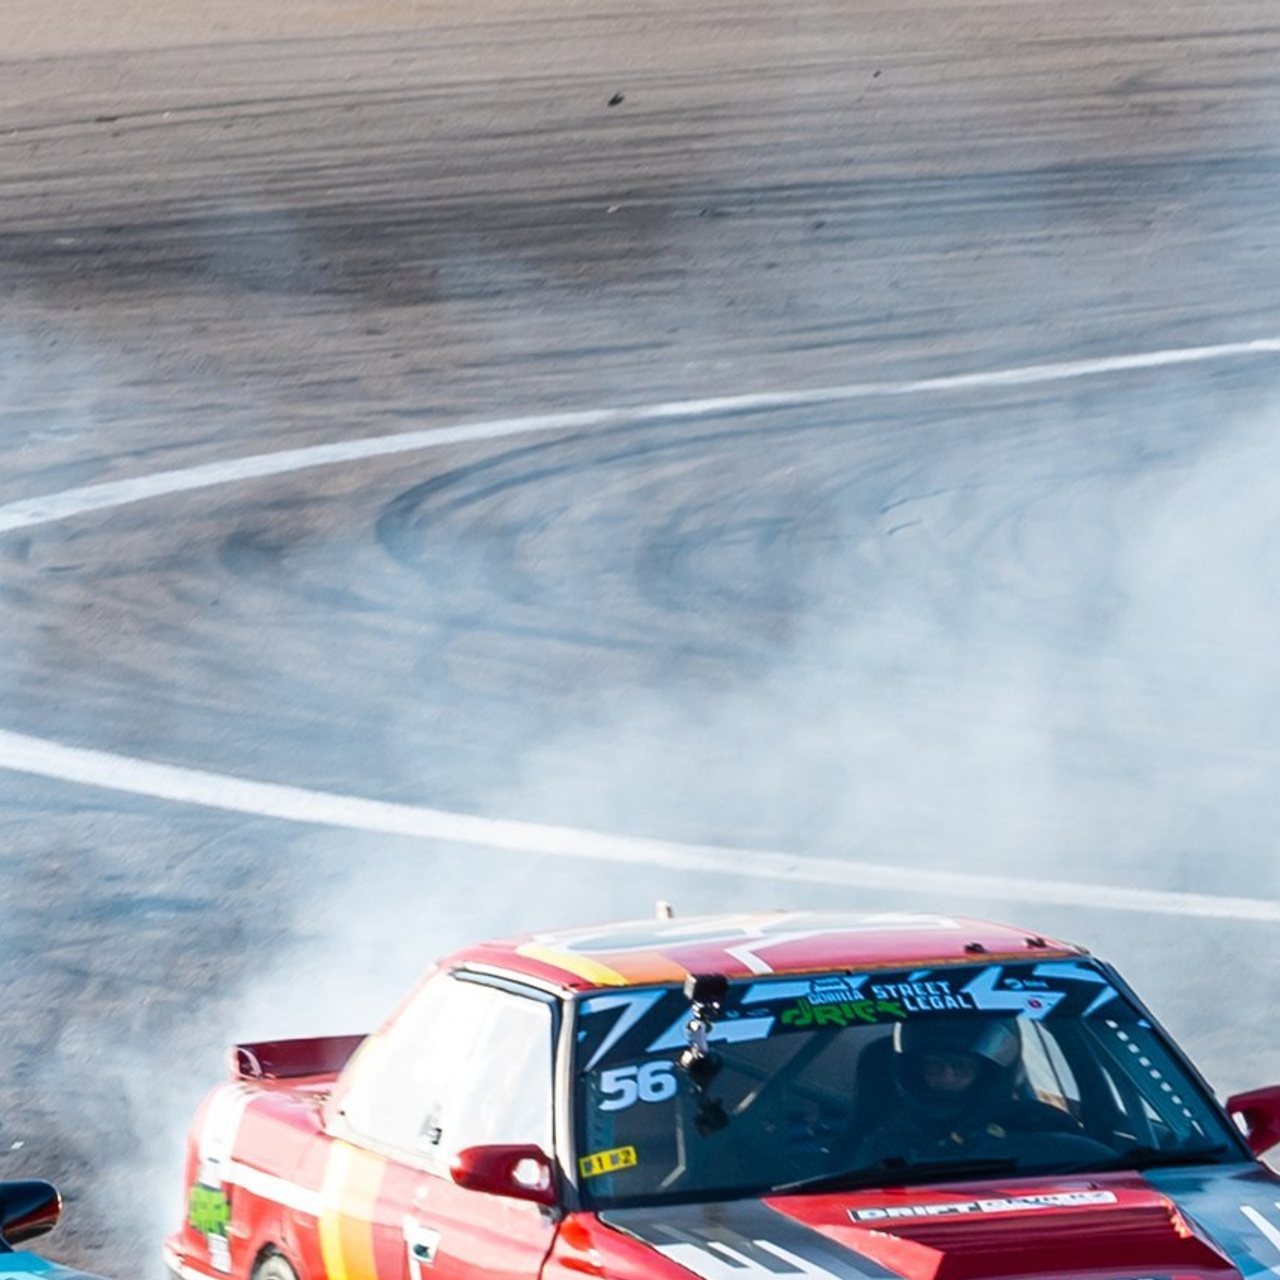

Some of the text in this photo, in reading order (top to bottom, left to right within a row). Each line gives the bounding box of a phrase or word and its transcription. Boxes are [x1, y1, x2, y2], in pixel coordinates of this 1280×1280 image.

[872, 981, 951, 999] STREET
[903, 995, 972, 1011] LEGAL
[598, 1060, 678, 1112] 56
[621, 1149, 632, 1164] 2
